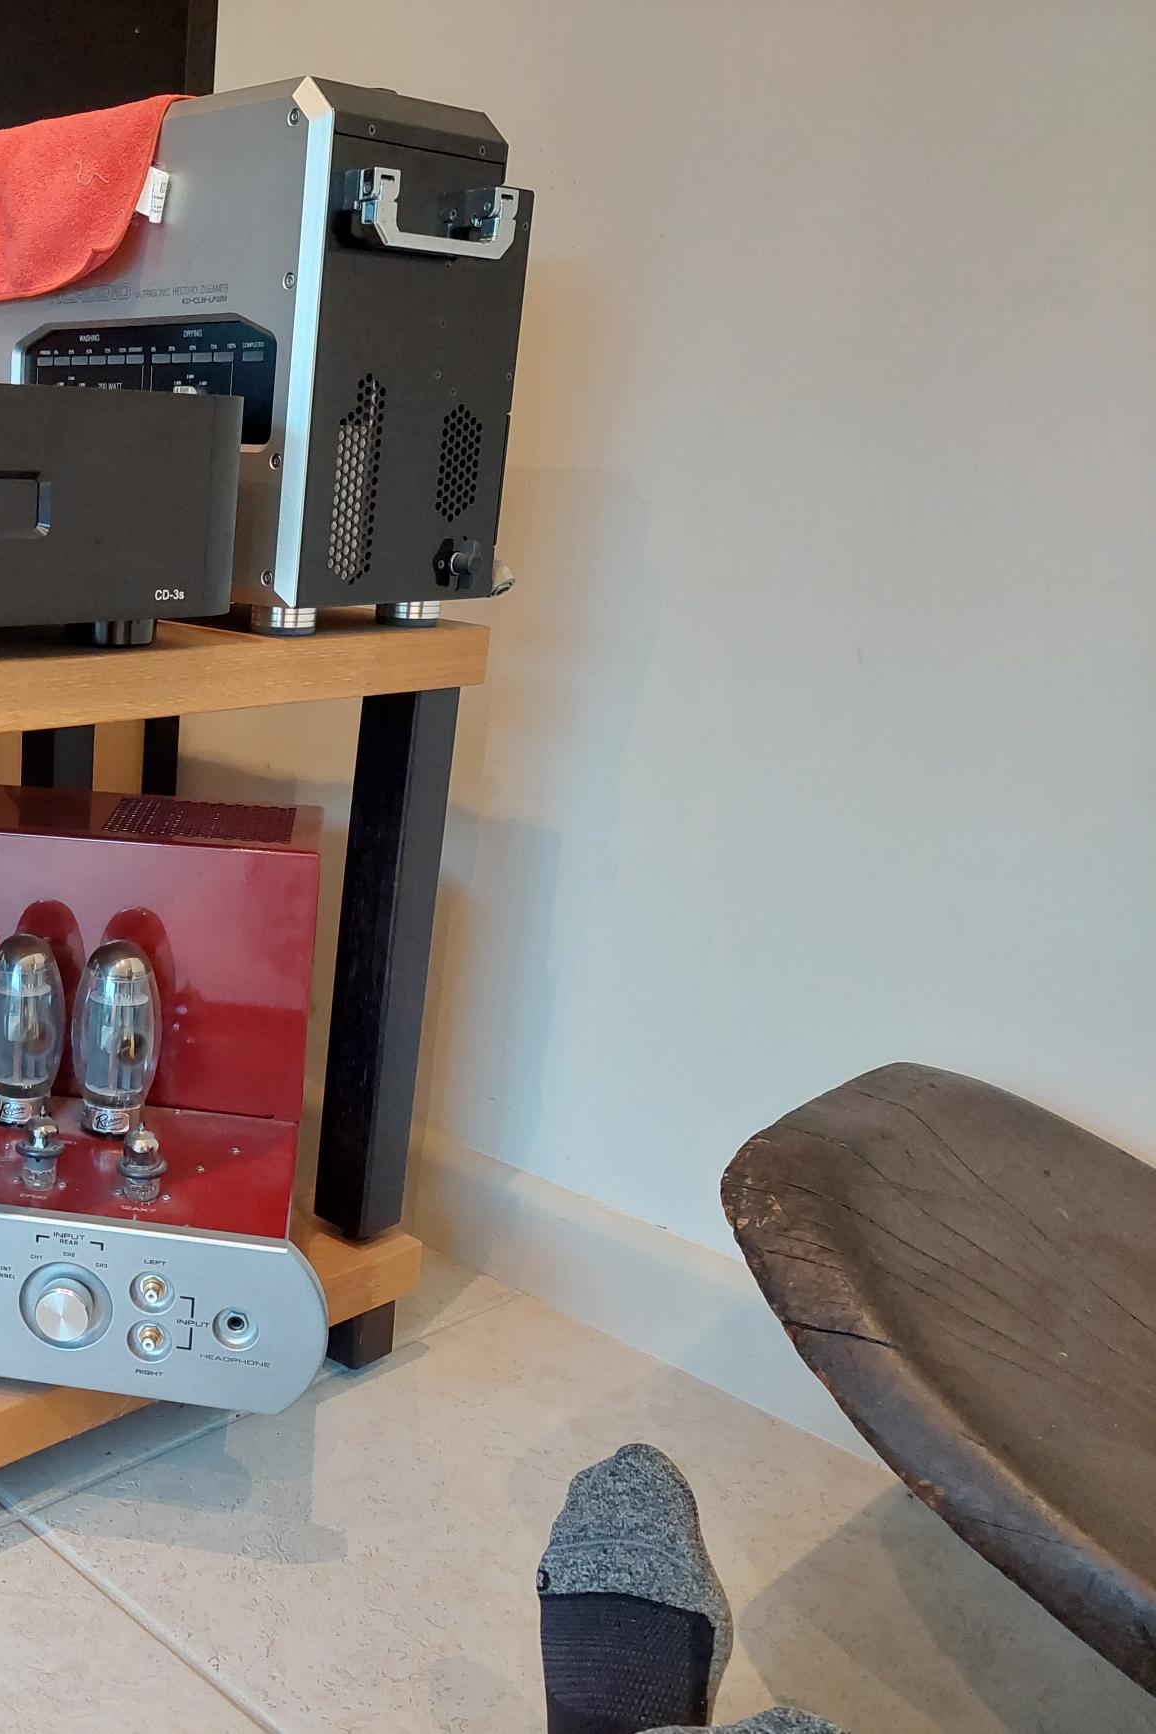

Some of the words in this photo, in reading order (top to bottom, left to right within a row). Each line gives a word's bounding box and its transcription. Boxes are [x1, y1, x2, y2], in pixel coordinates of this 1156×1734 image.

[199, 283, 229, 294] CLEANER
[182, 328, 204, 338] DRYING
[78, 334, 101, 343] WASHING
[108, 382, 123, 392] WATT
[154, 589, 185, 601] CD-3s
[53, 1231, 86, 1241] INPUT
[30, 1253, 43, 1261] CH1
[143, 1258, 167, 1267] LEFT
[176, 1317, 212, 1329] INPUT
[199, 1353, 271, 1369] HEADPHONE
[134, 1368, 165, 1377] RIGHT
